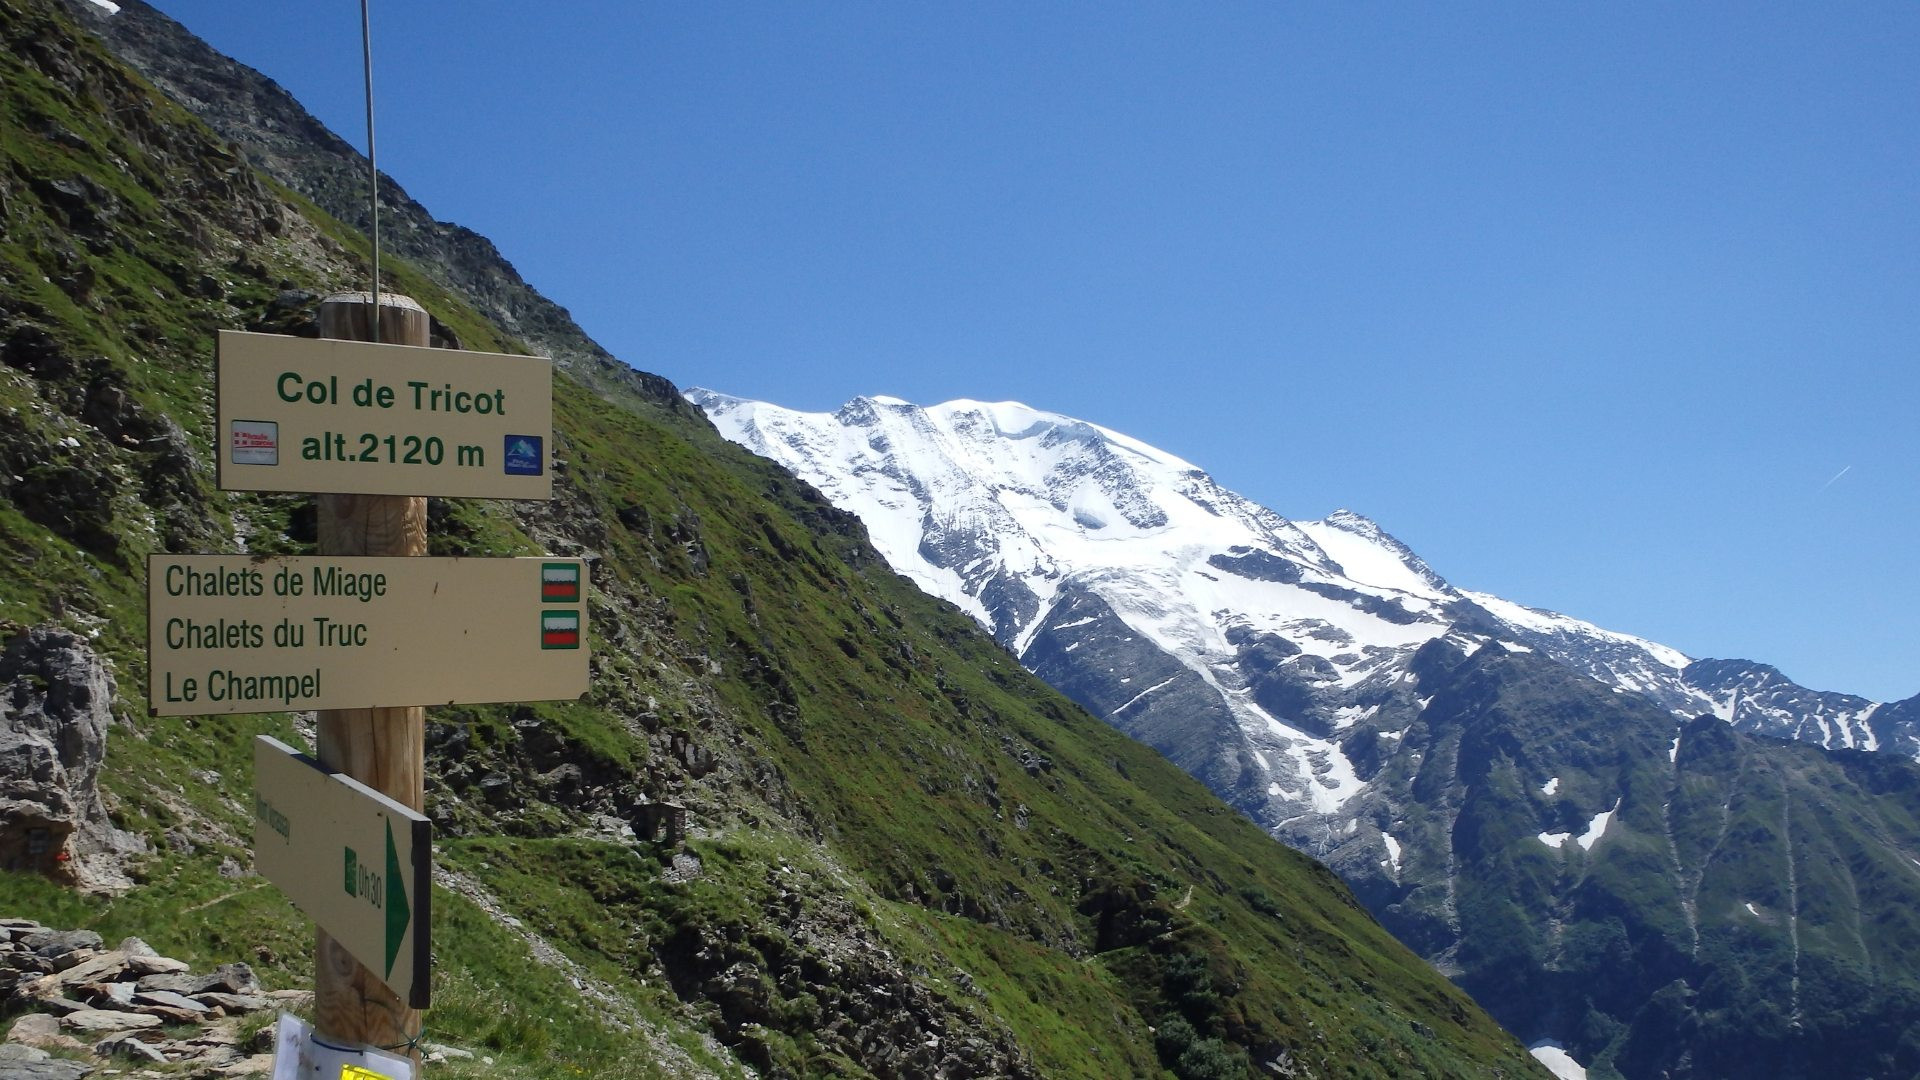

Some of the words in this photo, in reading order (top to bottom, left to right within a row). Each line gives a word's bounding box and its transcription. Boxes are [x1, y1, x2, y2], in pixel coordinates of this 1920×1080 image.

[277, 371, 338, 405] Col
[353, 378, 395, 409] de
[408, 381, 506, 416] Tricot
[301, 431, 445, 466] alt.2120
[457, 444, 485, 467] m
[166, 564, 264, 597] Chalets
[273, 566, 304, 596] de
[313, 566, 387, 602] Miage
[166, 618, 264, 650] Chalets
[274, 618, 304, 648] du
[313, 617, 368, 647] Truc
[166, 671, 197, 703] Le
[208, 668, 321, 705] Champel
[359, 863, 382, 910] 0h30
